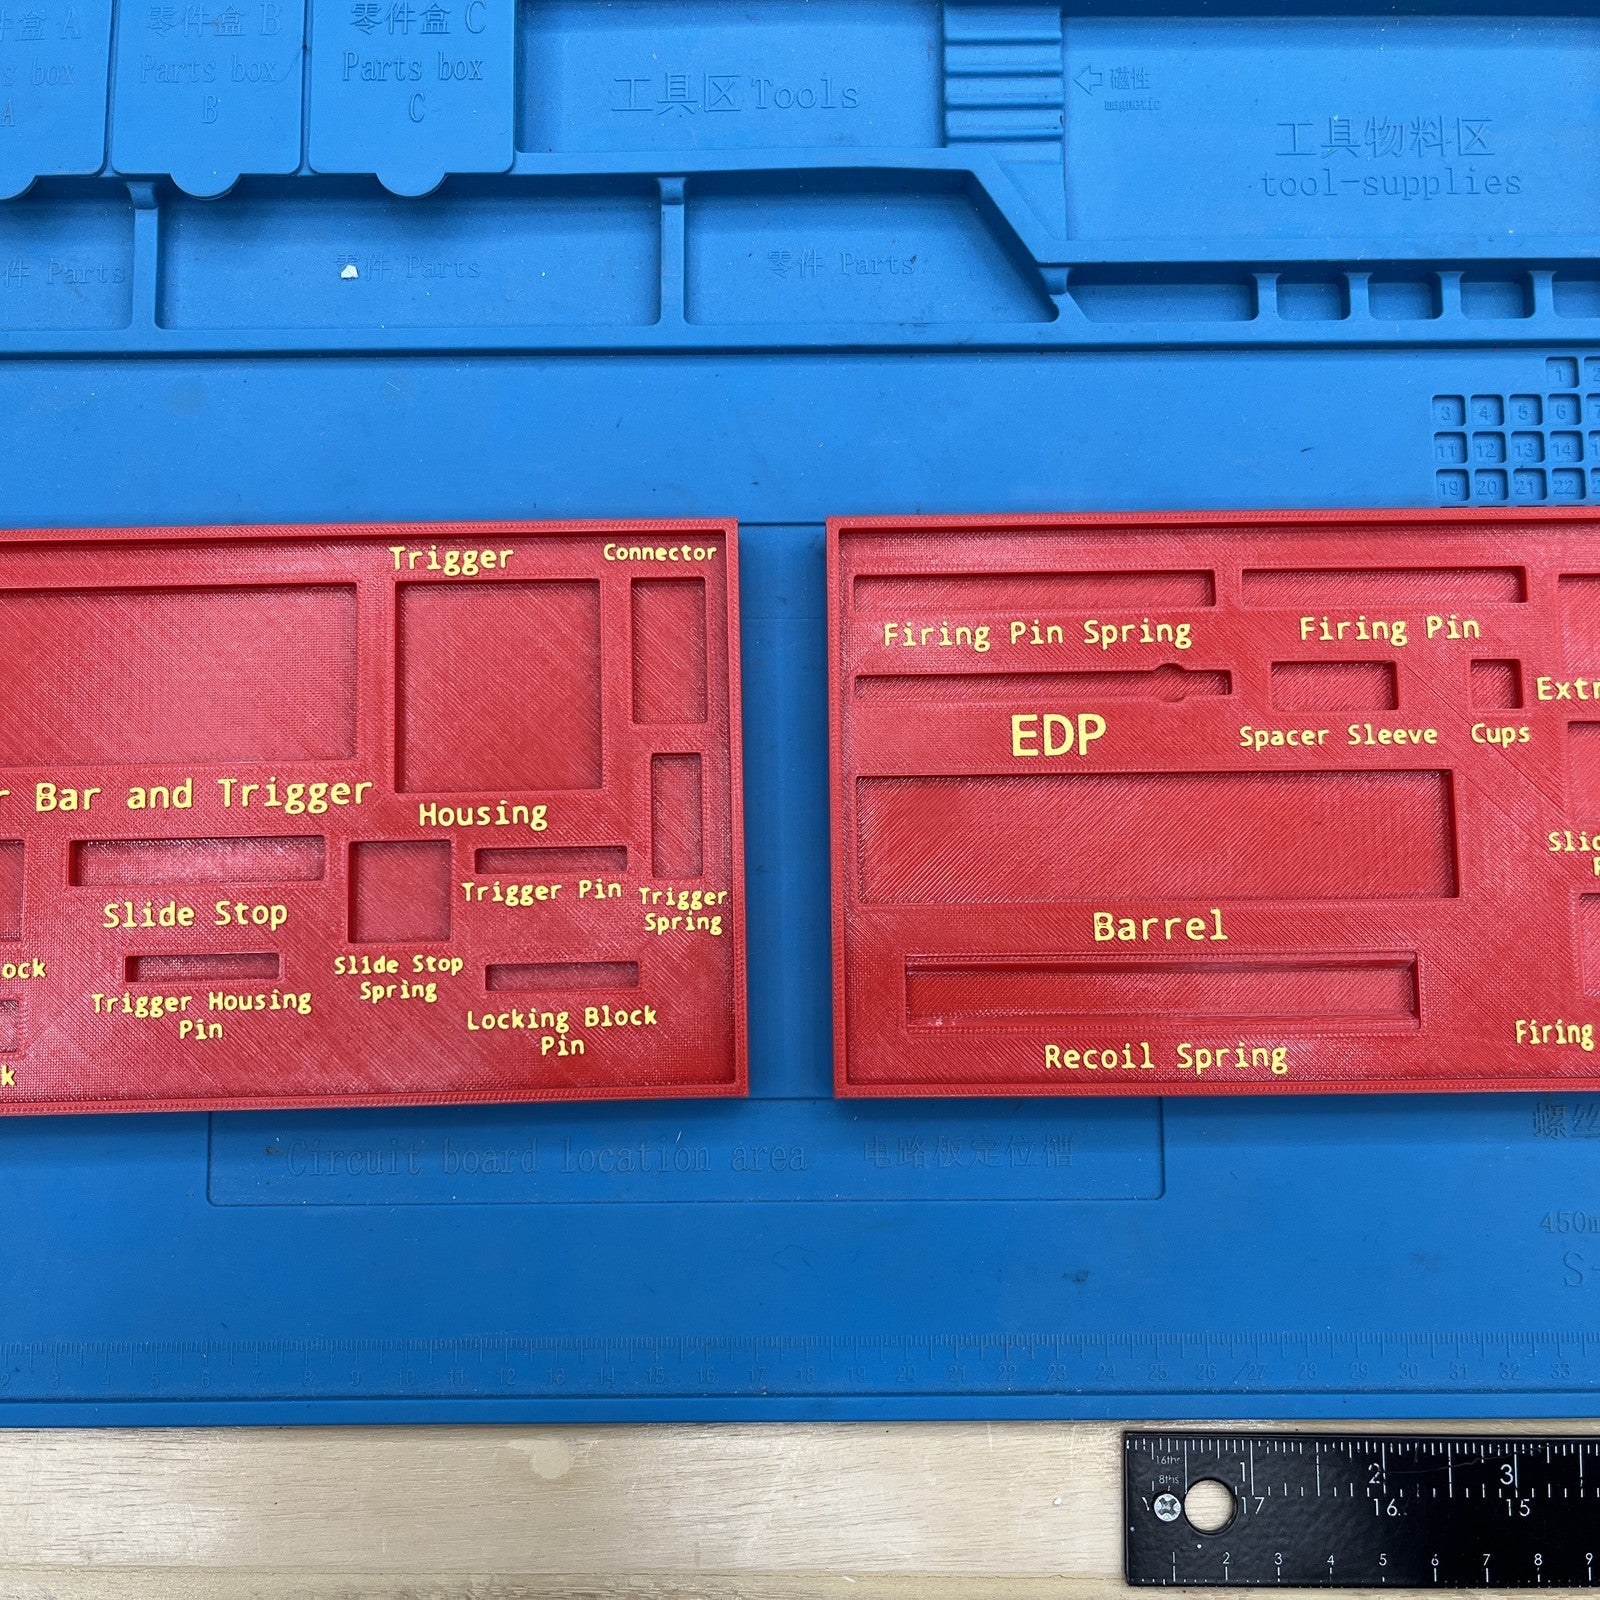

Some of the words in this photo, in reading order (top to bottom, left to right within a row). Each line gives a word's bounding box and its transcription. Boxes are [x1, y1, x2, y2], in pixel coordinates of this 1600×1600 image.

[145, 4, 247, 38] 零件盒
[259, 4, 281, 36] B
[350, 1, 452, 36] 零件盒
[464, 1, 487, 35] C
[32, 57, 76, 87] box
[140, 54, 216, 84] Parts
[230, 53, 277, 83] box
[343, 51, 422, 82] Parts
[438, 51, 484, 82] box
[1110, 66, 1151, 90] 磁性
[409, 93, 425, 123] C
[611, 72, 741, 117] 工具区
[751, 73, 861, 110] Tools
[1104, 97, 1160, 113] magnetic
[202, 95, 218, 124] B
[1275, 115, 1496, 160] 工具物料区
[1261, 167, 1522, 201] tool-supplies
[47, 260, 125, 285] Parts
[406, 255, 482, 280] Parts
[768, 249, 825, 279] 零件
[840, 251, 916, 277] Parts
[1441, 405, 1451, 421] 3
[1479, 404, 1490, 420] 4
[1518, 403, 1529, 420] 5
[1556, 404, 1567, 420] 6
[1438, 444, 1457, 458] 11
[1477, 443, 1497, 458] 12
[1515, 443, 1535, 458] 13
[1553, 443, 1571, 457] 14
[1440, 480, 1459, 496] 19
[1477, 480, 1497, 496] 20
[1515, 479, 1535, 495] 21
[1553, 479, 1575, 495] 22
[389, 544, 514, 577] Trigger
[603, 544, 717, 561] Connector
[884, 622, 991, 653] Firing
[1010, 621, 1064, 645] Pin
[1083, 619, 1193, 650] Spring
[1299, 616, 1408, 647] Firing
[1426, 615, 1481, 640] Pin
[1011, 713, 1107, 757] EDP
[1239, 726, 1329, 752] Spacer
[1347, 724, 1438, 746] Sleeve
[1471, 723, 1531, 749] Cups
[35, 782, 102, 812] Bar
[127, 778, 193, 810] and
[217, 776, 373, 815] Trigger
[419, 799, 548, 832] Housing
[462, 881, 561, 907] Trigger
[578, 880, 622, 900] Pin
[639, 886, 728, 911] Trigger
[103, 901, 195, 929] Slide
[215, 901, 288, 932] Stop
[644, 909, 723, 936] Spring
[1093, 908, 1229, 942] Barrel
[334, 956, 400, 975] Slide
[412, 954, 464, 976] Stop
[91, 993, 193, 1019] Trigger
[208, 990, 312, 1015] Housing
[360, 979, 438, 1004] Spring
[179, 1019, 223, 1040] Pin
[467, 1007, 570, 1034] Locking
[584, 1004, 657, 1028] Block
[541, 1034, 585, 1057] Pin
[1515, 1019, 1595, 1052] Firing
[1044, 1041, 1155, 1070] Recoil
[1176, 1041, 1289, 1075] Spring
[287, 1138, 422, 1176] Circuit
[442, 1136, 540, 1174] board
[560, 1136, 712, 1174] location
[730, 1143, 809, 1172] area
[863, 1134, 1075, 1169] 电路板定位槽
[151, 1372, 160, 1389] 5
[202, 1371, 211, 1388] 6
[303, 1370, 313, 1386] 8
[351, 1370, 360, 1386] 9
[448, 1369, 464, 1385] 11
[499, 1368, 517, 1385] 12
[598, 1367, 616, 1384] 14
[647, 1367, 665, 1384] 15
[899, 1365, 917, 1382] 20
[949, 1365, 967, 1382] 21
[999, 1363, 1017, 1382] 22
[1048, 1364, 1067, 1382] 23
[1097, 1363, 1116, 1381] 24
[1149, 1363, 1168, 1381] 25
[1198, 1362, 1217, 1381] 26
[1248, 1362, 1267, 1380] 27
[1298, 1362, 1318, 1380] 28
[1350, 1362, 1369, 1380] 29
[1399, 1362, 1419, 1380] 30
[1449, 1362, 1469, 1380] 31
[1500, 1361, 1521, 1379] 32
[1550, 1362, 1571, 1379] 33
[1158, 1474, 1180, 1484] 8ths
[1239, 1461, 1246, 1483] 1
[1368, 1463, 1381, 1484] 2
[1499, 1463, 1514, 1485] 3
[1240, 1496, 1266, 1515] 17
[1373, 1498, 1399, 1517] 16
[1505, 1498, 1531, 1517] 15
[1171, 1551, 1176, 1564] 1
[1222, 1551, 1230, 1565] 2
[1274, 1552, 1283, 1566] 3
[1326, 1554, 1335, 1566] 4
[1378, 1553, 1387, 1566] 5
[1431, 1553, 1439, 1566] 6
[1483, 1553, 1491, 1566] 7
[1534, 1553, 1543, 1566] 8
[1585, 1552, 1594, 1565] 9
